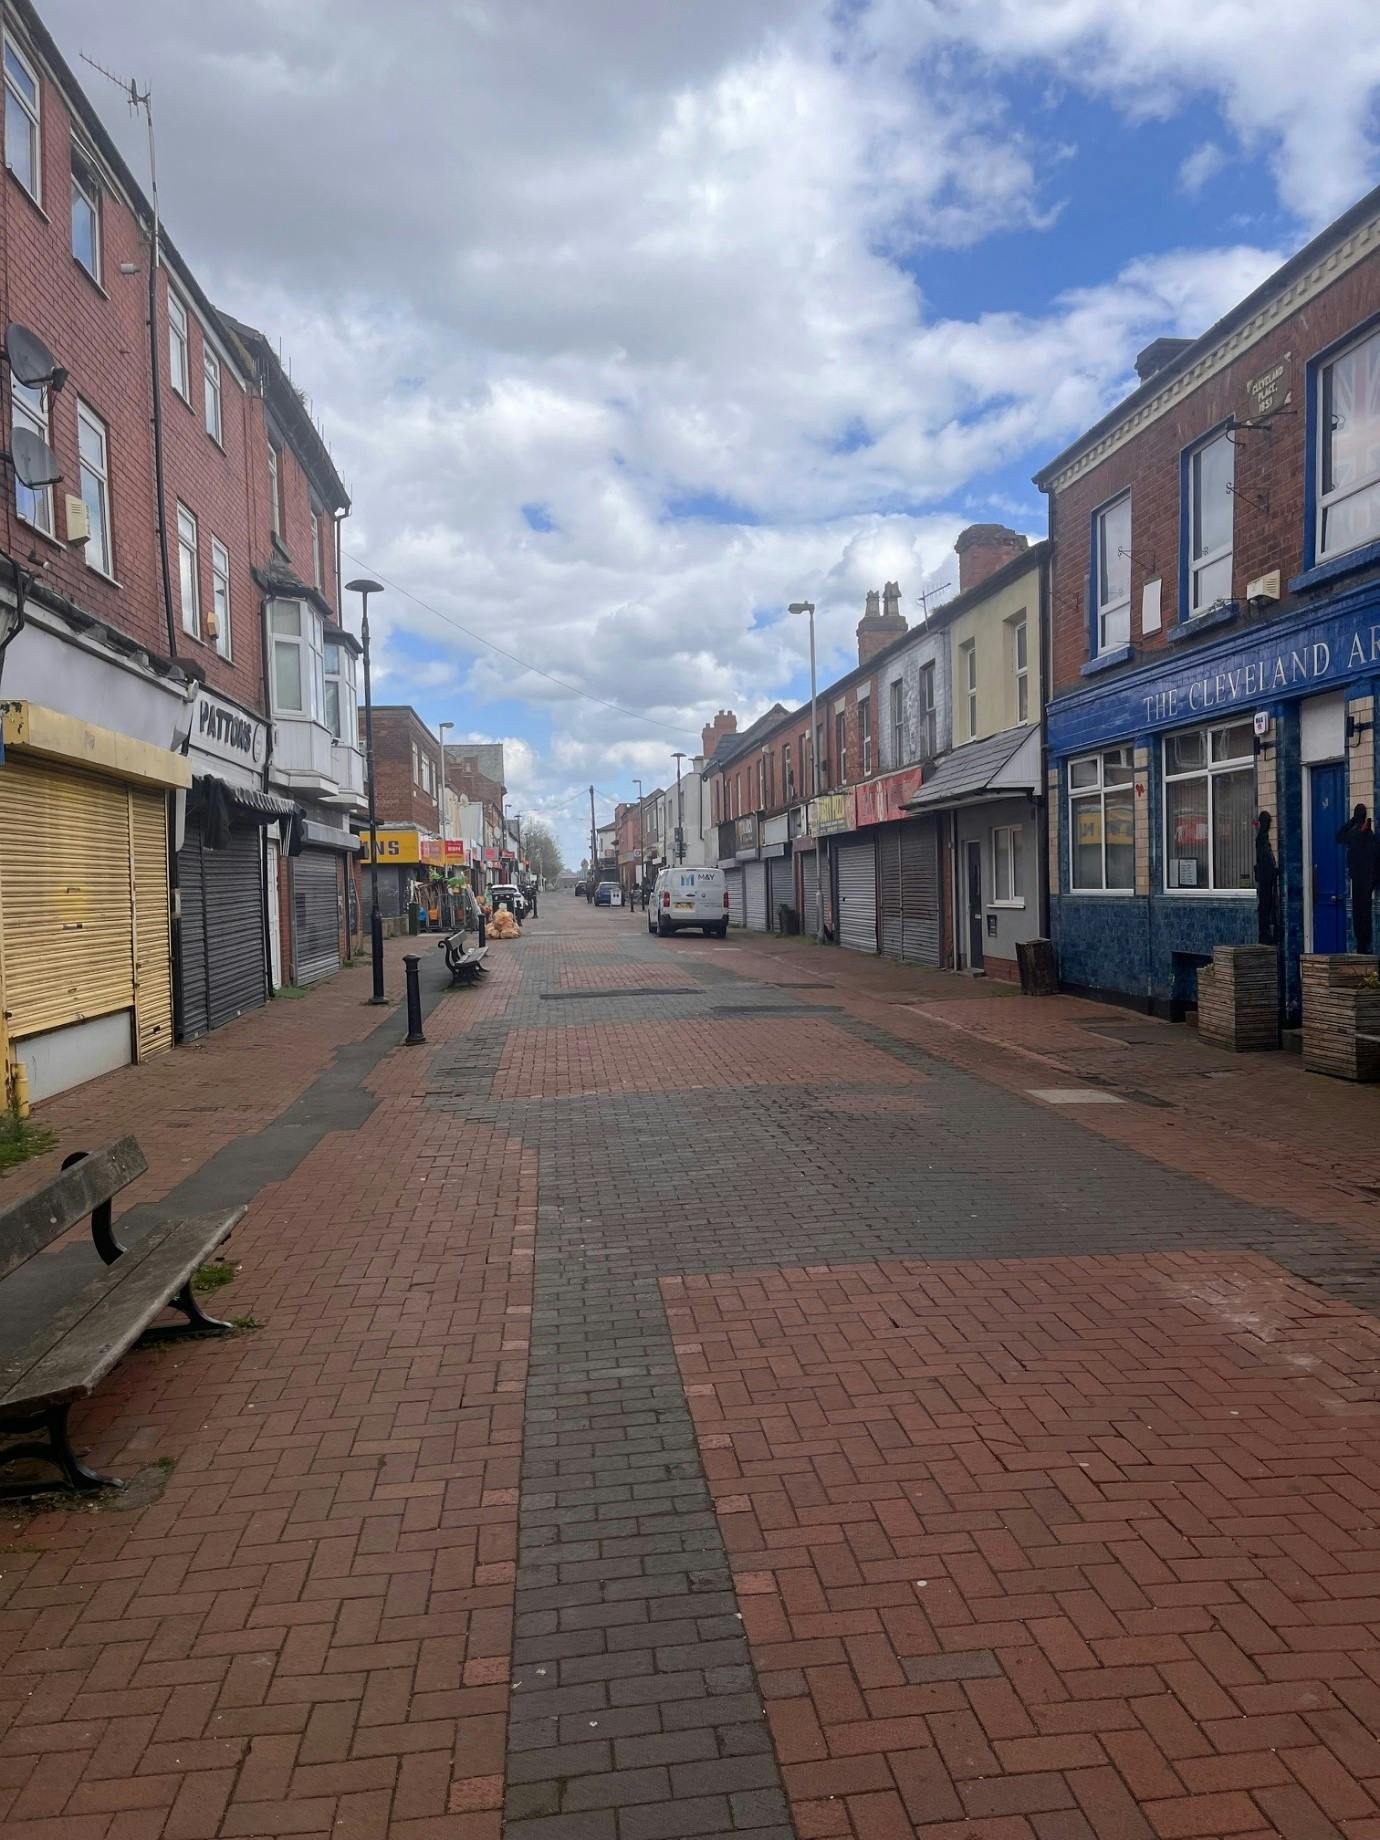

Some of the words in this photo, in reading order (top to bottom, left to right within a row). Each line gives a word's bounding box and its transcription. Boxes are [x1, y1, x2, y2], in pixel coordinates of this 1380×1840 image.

[1143, 690, 1177, 722] THE
[1189, 642, 1330, 710] CLEVELAND
[200, 700, 252, 753] PATTONS
